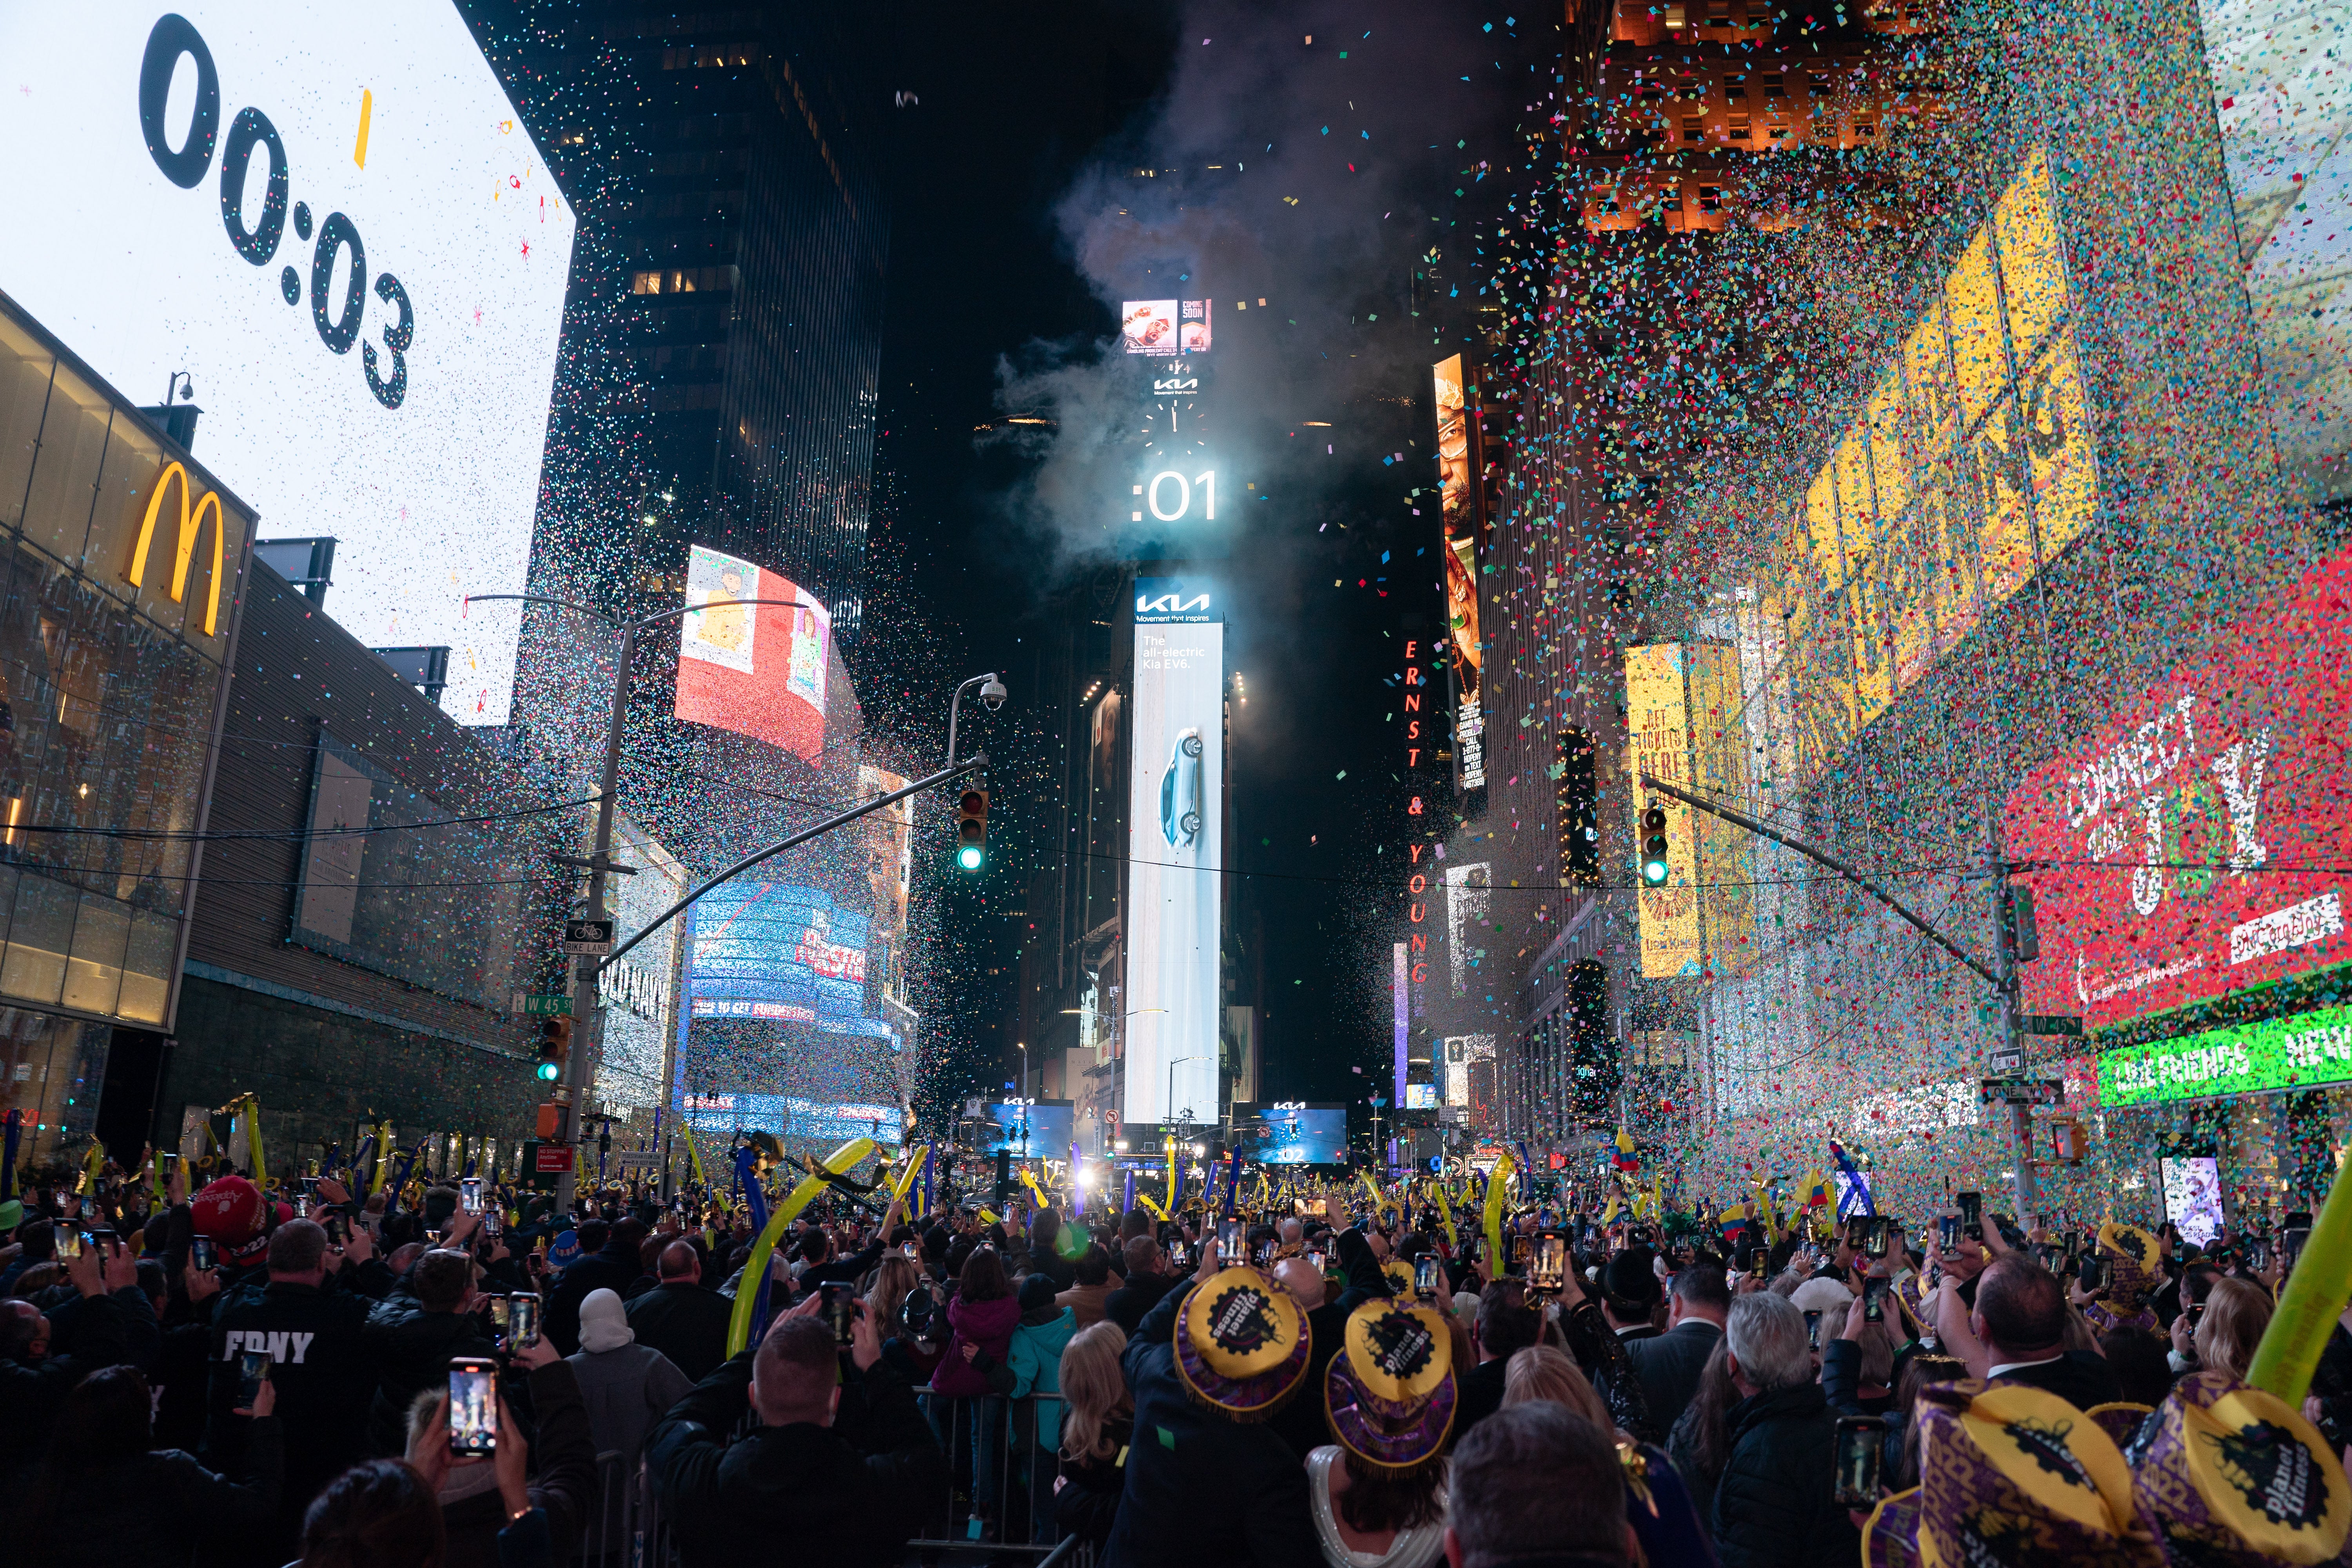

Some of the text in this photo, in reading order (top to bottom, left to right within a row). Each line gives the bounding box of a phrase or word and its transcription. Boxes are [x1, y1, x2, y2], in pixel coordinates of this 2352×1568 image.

[138, 13, 414, 410] 00:03
[1183, 308, 1203, 318] SOON
[1154, 379, 1198, 389] KIA
[1132, 471, 1214, 521] :01
[1137, 594, 1209, 612] KIA
[1143, 636, 1165, 646] The
[1143, 647, 1205, 657] all-electric
[1143, 659, 1190, 669] Kia EV6.
[1648, 710, 1665, 728] GET
[1466, 738, 1477, 746] CALL
[1638, 731, 1681, 750] TICKETS
[1463, 746, 1482, 755] 1-877-8-
[1464, 752, 1481, 764] HOPENY
[1470, 761, 1481, 770] TEXT
[1465, 769, 1482, 780] HOPENY
[1464, 777, 1485, 790] (467369)
[1406, 642, 1427, 983] ERNST & YOUNG
[566, 943, 608, 953] BIKE LANE
[599, 956, 666, 1021] OLD NAVY
[528, 998, 572, 1012] W 45 St
[732, 1002, 751, 1014] GET
[2036, 1018, 2047, 1032] W
[2053, 1019, 2067, 1033] 45
[2285, 1024, 2352, 1068] NEW
[1993, 1059, 2002, 1069] ONE
[2158, 1042, 2250, 1085] FRIENDS
[1994, 1087, 2016, 1097] ONE
[1004, 1097, 1035, 1105] KIA
[1274, 1102, 1305, 1110] KIA
[1212, 1292, 1247, 1339] fitness
[1228, 1291, 1260, 1338] planet
[223, 1331, 314, 1364] FDNY
[1385, 1328, 1415, 1373] planet
[1394, 1330, 1430, 1372] fitness
[2265, 1443, 2294, 1519] planet
[2285, 1443, 2309, 1518] fitness
